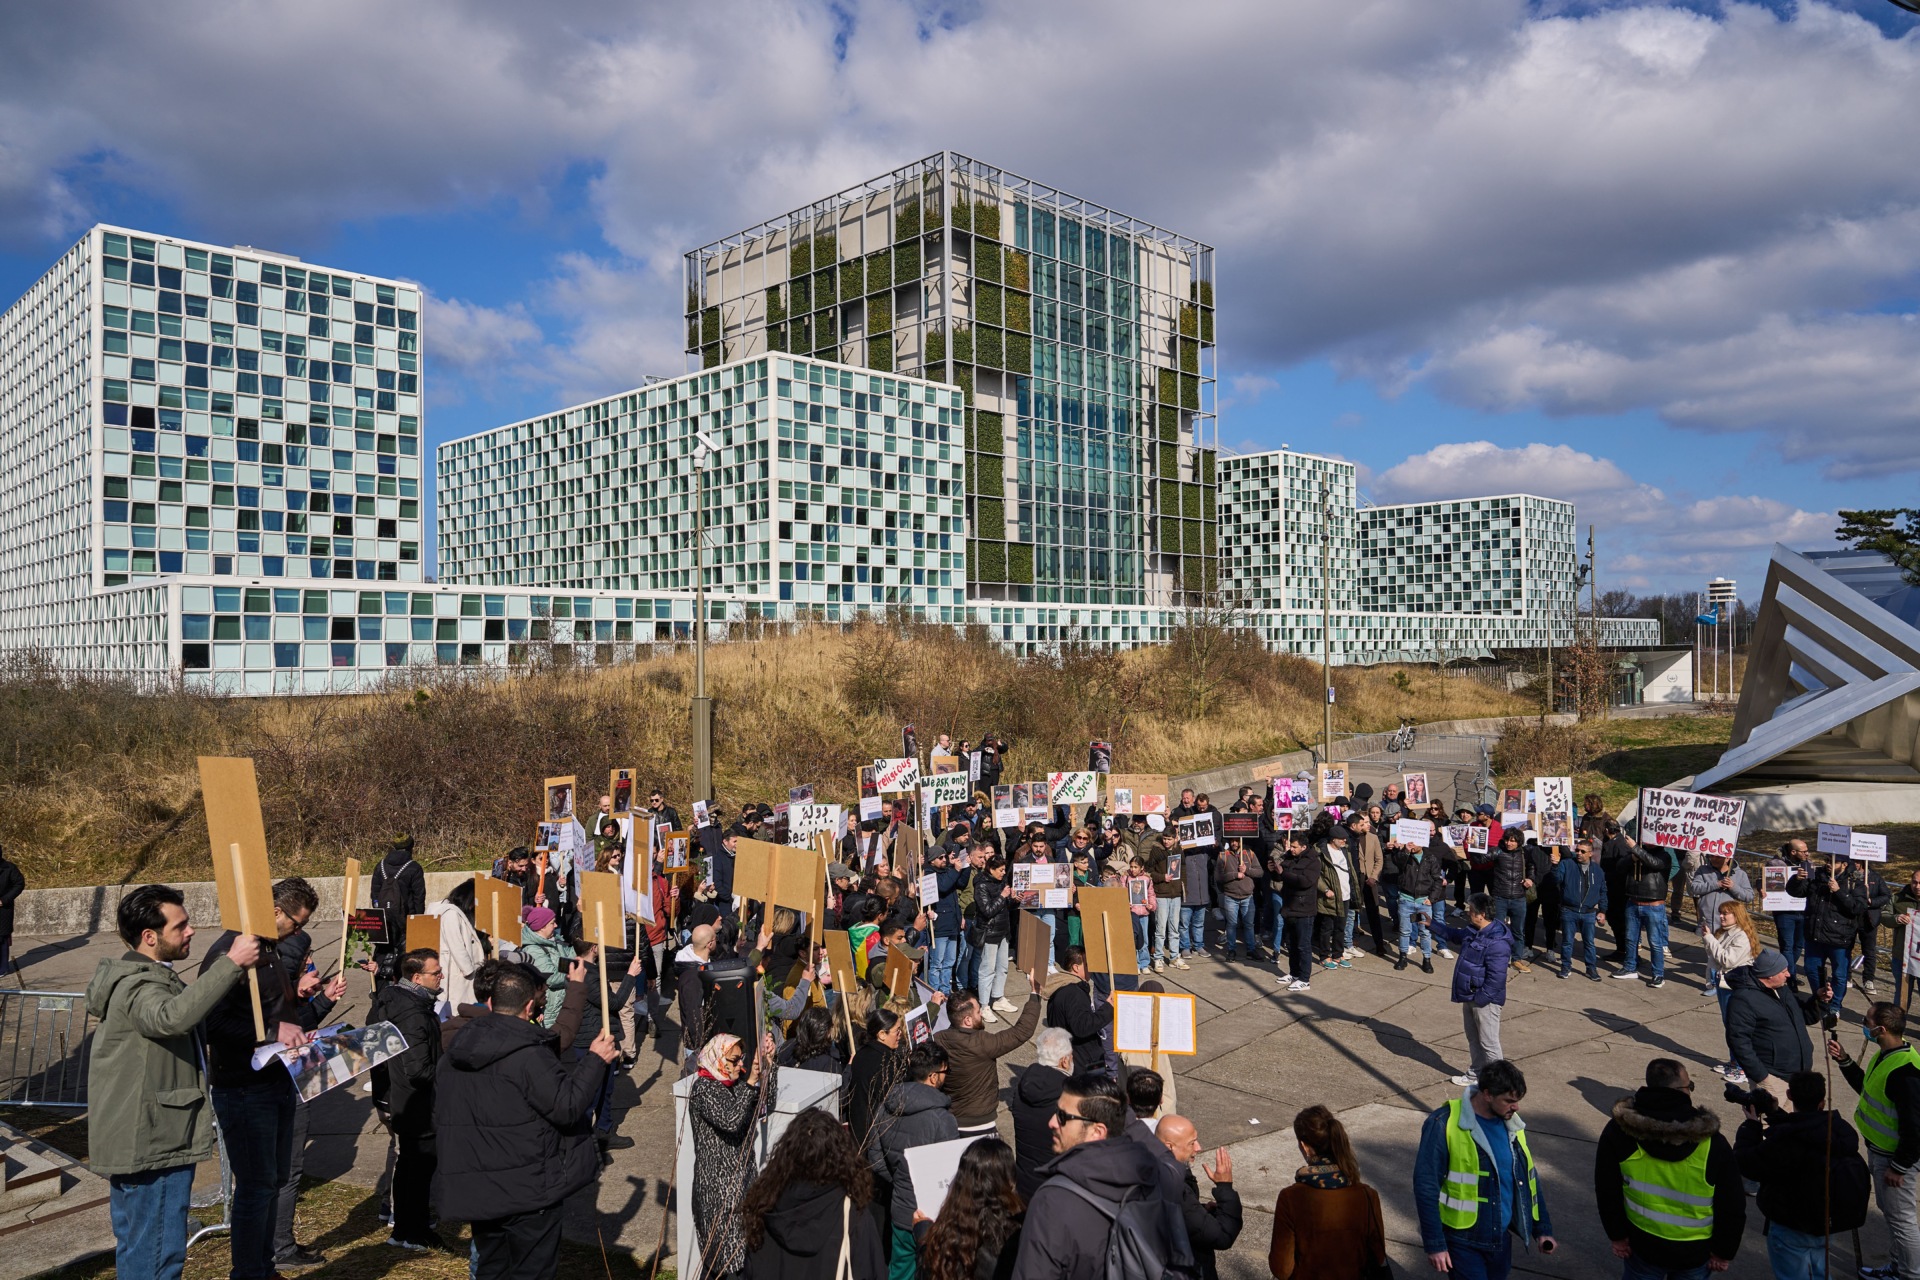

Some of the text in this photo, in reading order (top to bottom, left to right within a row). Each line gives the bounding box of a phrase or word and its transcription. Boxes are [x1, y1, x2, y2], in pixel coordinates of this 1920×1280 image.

[875, 760, 887, 774] NO
[878, 758, 912, 790] religious
[936, 776, 949, 787] ask
[952, 775, 966, 786] only
[1052, 773, 1079, 804] terrorism
[1065, 786, 1074, 796] in
[1073, 775, 1093, 801] Syria
[802, 805, 828, 820] دولة
[1650, 790, 1740, 815] How many
[1643, 816, 1705, 837] before the
[1646, 806, 1738, 827] more must die
[1700, 837, 1734, 857] acts
